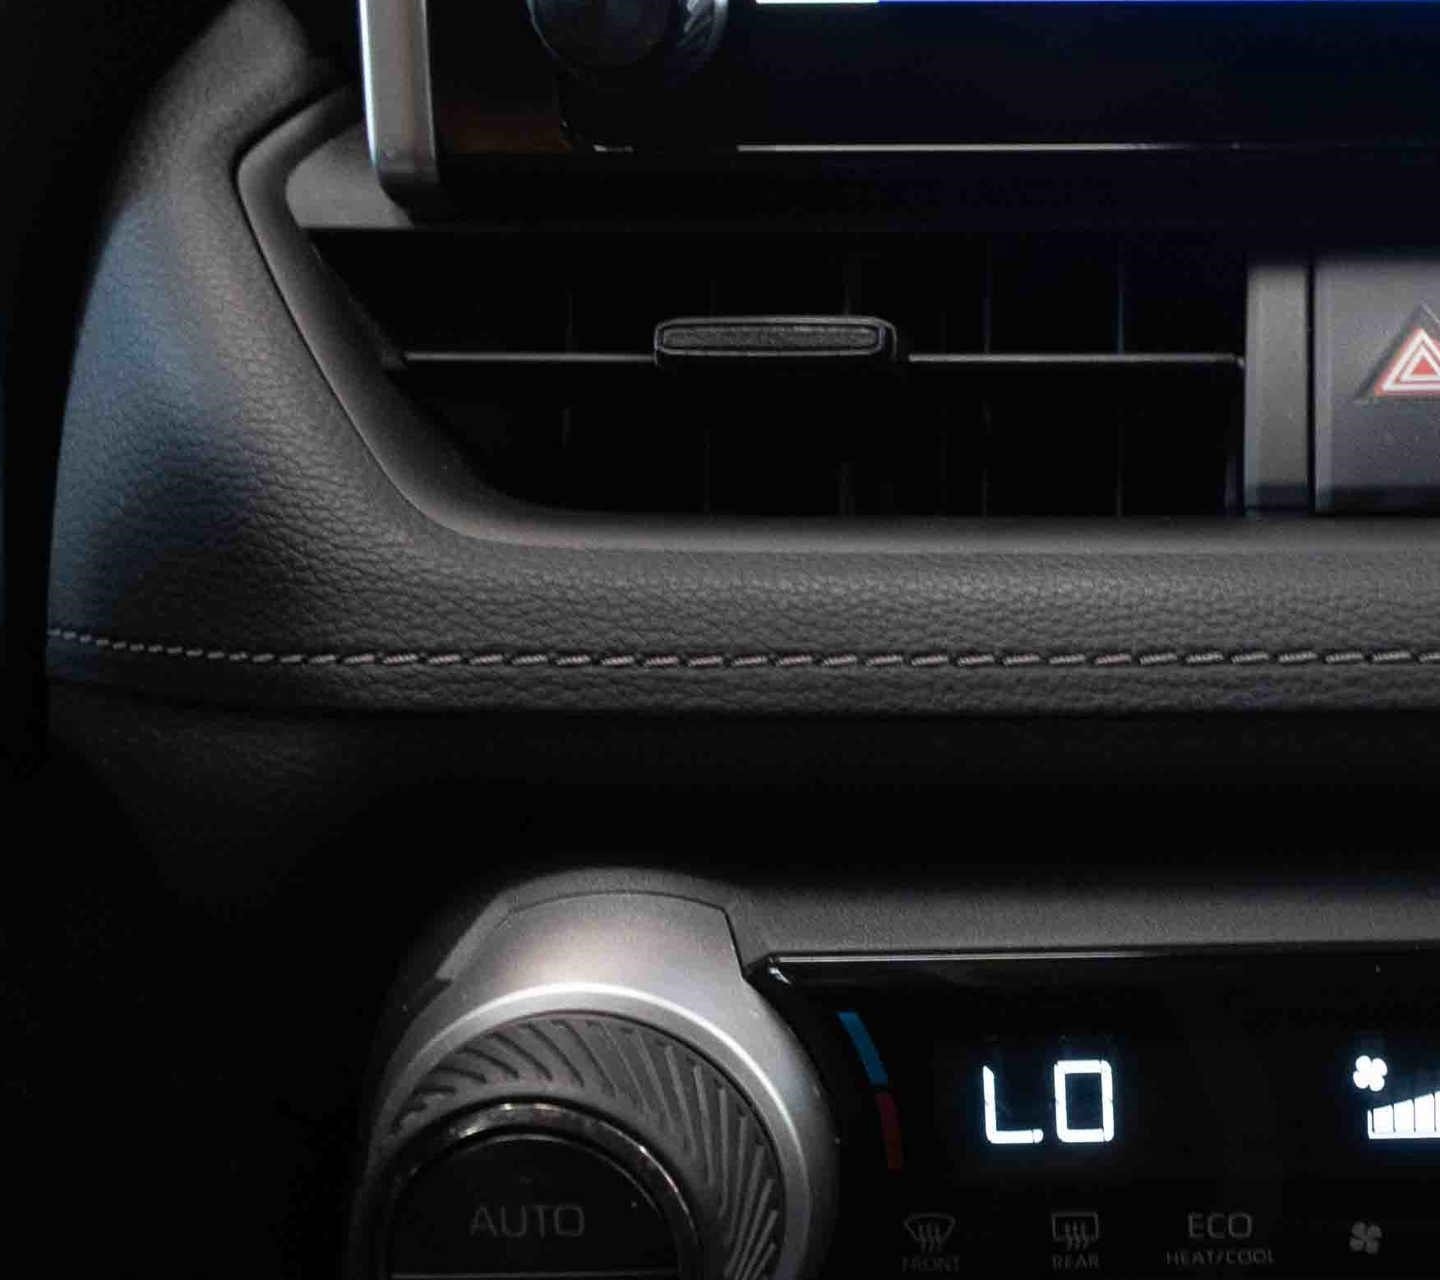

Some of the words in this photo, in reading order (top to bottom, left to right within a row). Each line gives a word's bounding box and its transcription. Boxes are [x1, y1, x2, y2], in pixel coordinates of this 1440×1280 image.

[983, 1059, 1115, 1145] LO
[469, 1203, 585, 1239] AUTO
[1186, 1211, 1254, 1241] ECO
[1051, 1253, 1101, 1271] REAR
[1164, 1247, 1276, 1267] HEAT/COOL
